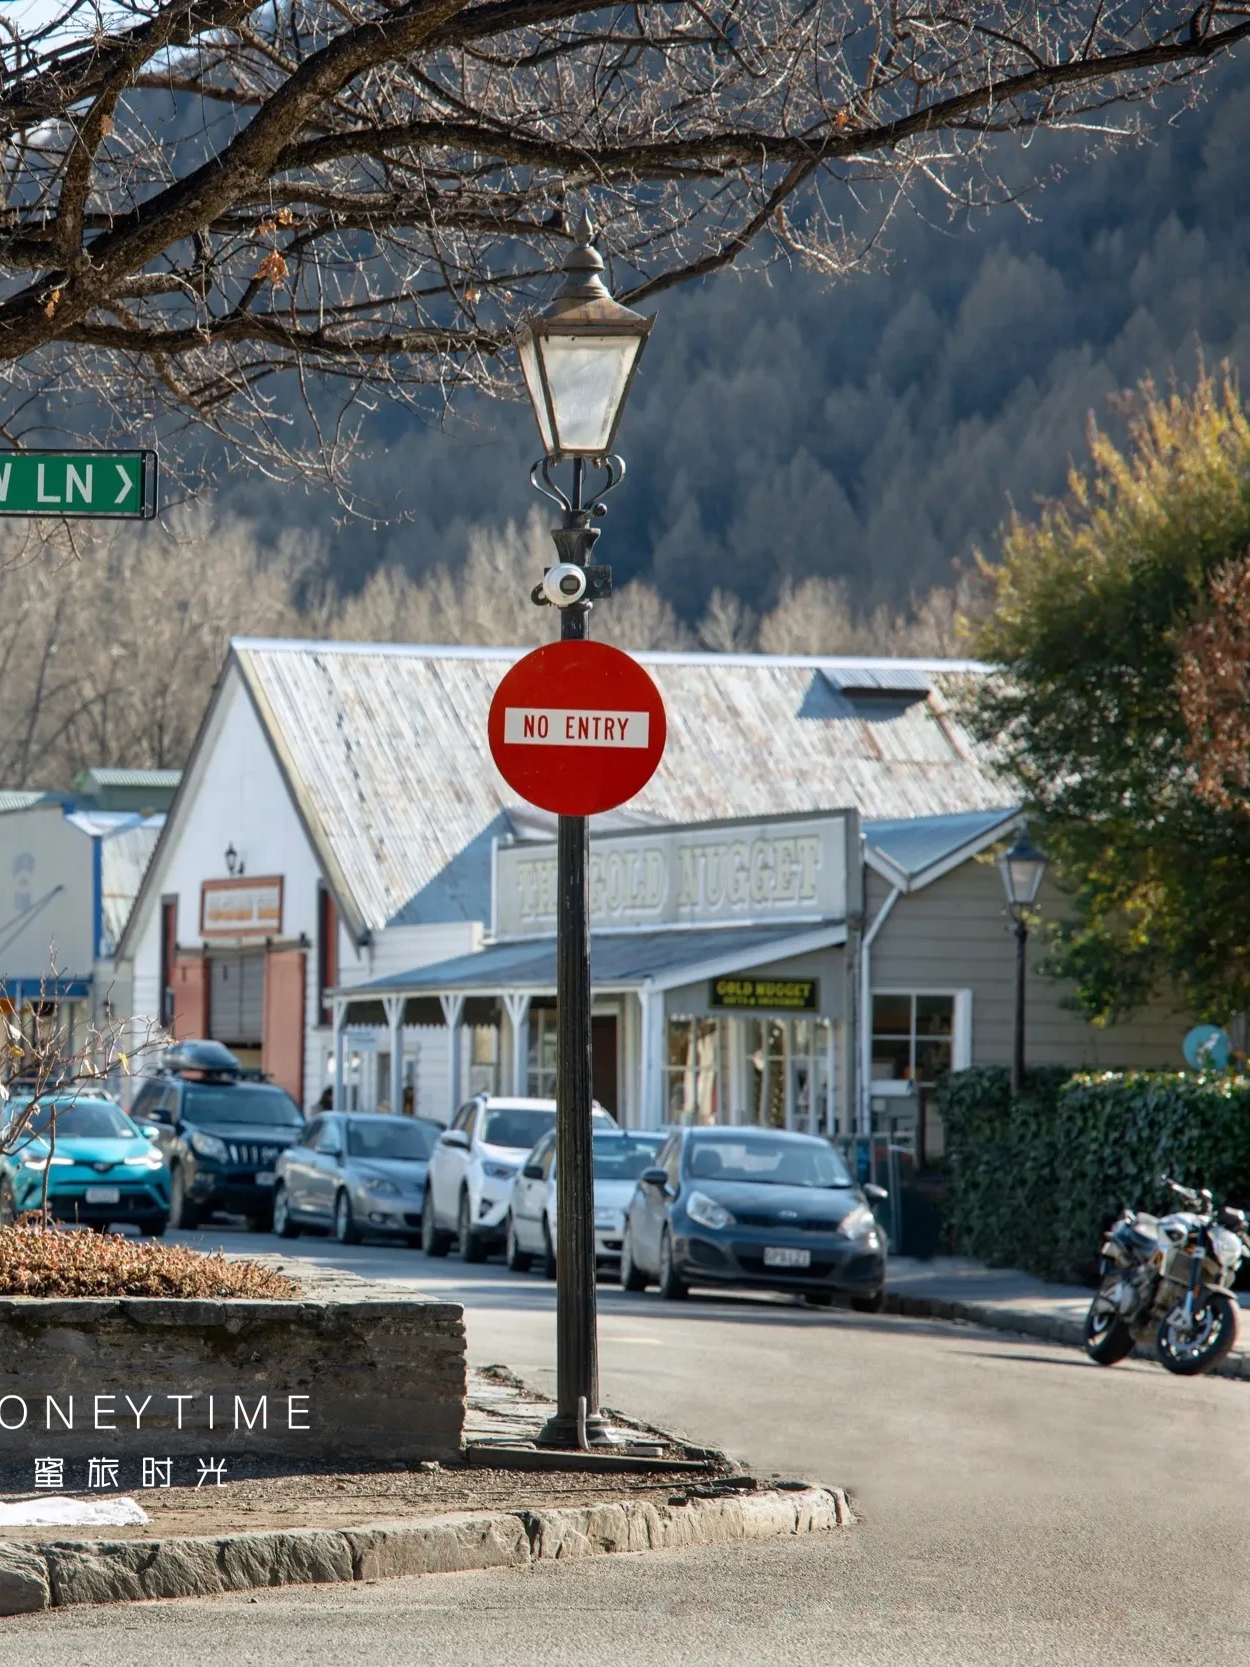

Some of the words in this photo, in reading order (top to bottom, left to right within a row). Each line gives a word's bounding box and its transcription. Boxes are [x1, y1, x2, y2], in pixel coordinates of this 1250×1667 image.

[37, 463, 93, 503] LN
[523, 714, 549, 739] NO
[565, 715, 629, 741] ENTRY
[517, 858, 558, 923] TH
[588, 846, 665, 918] GOLD
[677, 834, 822, 913] NUGGET
[716, 981, 752, 996] GOLD
[755, 982, 812, 998] NUGGET
